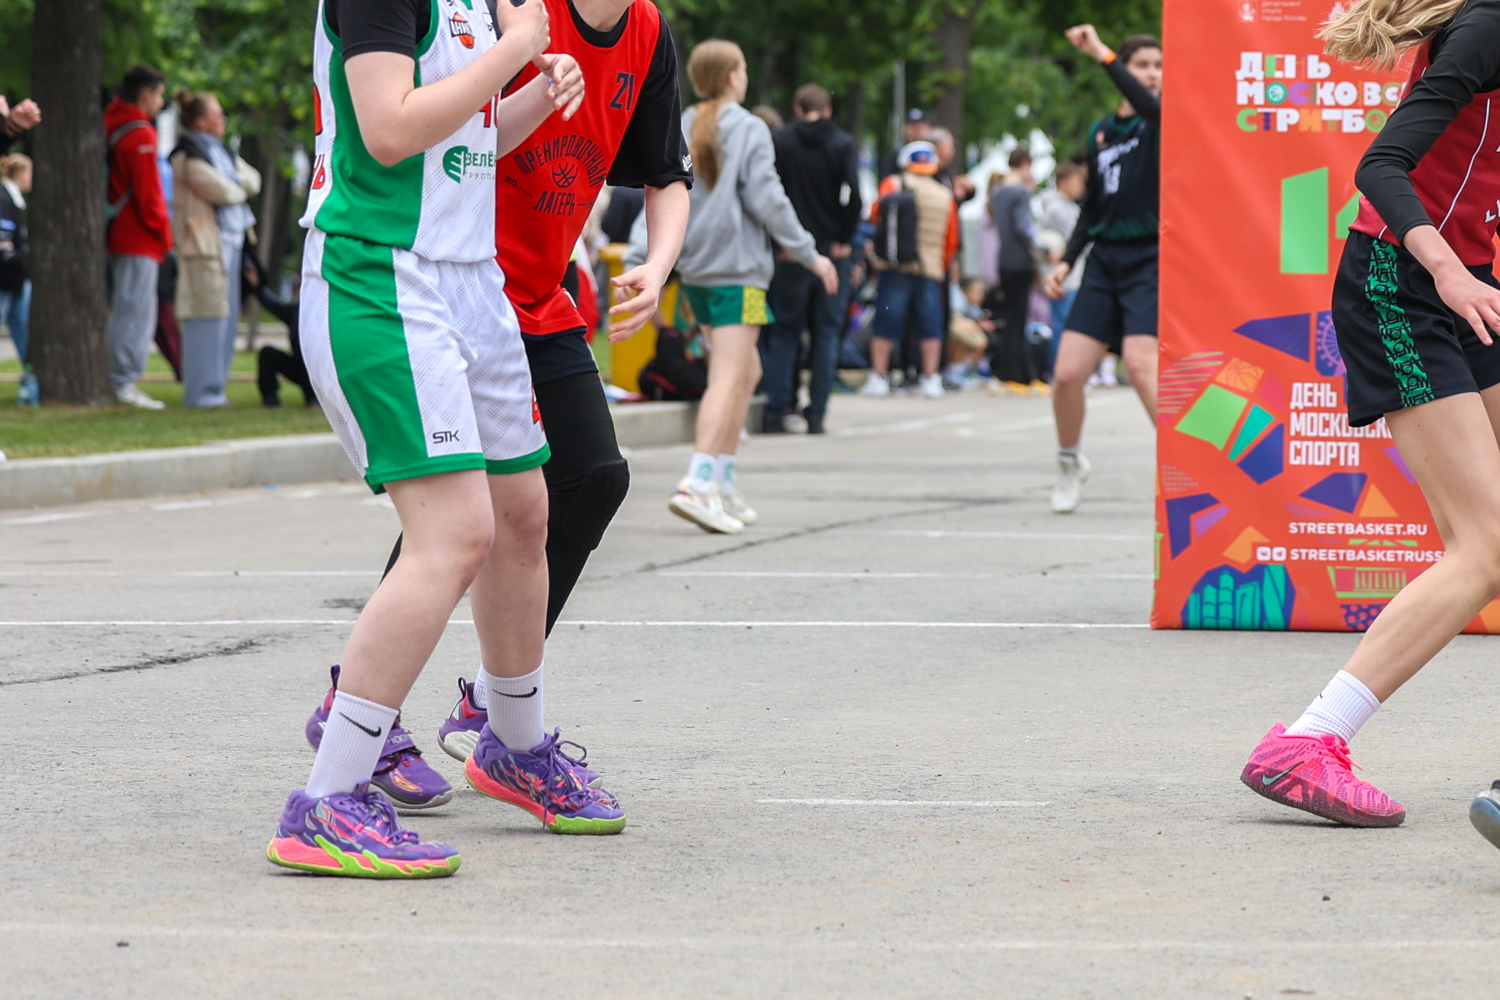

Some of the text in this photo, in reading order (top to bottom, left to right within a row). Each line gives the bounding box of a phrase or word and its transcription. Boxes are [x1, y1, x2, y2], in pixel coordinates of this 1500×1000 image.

[1235, 52, 1331, 81] ДЕНЬ
[610, 72, 635, 110] 21
[1236, 80, 1407, 106] МОСКОВС
[1236, 107, 1397, 133] СТРИТБО
[533, 190, 576, 216] ЛАГЕРЬ
[1290, 382, 1337, 410] ДЕНЬ
[432, 430, 460, 444] STK
[1289, 440, 1360, 466] СПОРТА
[1289, 522, 1428, 536] STREETBASKET.RU
